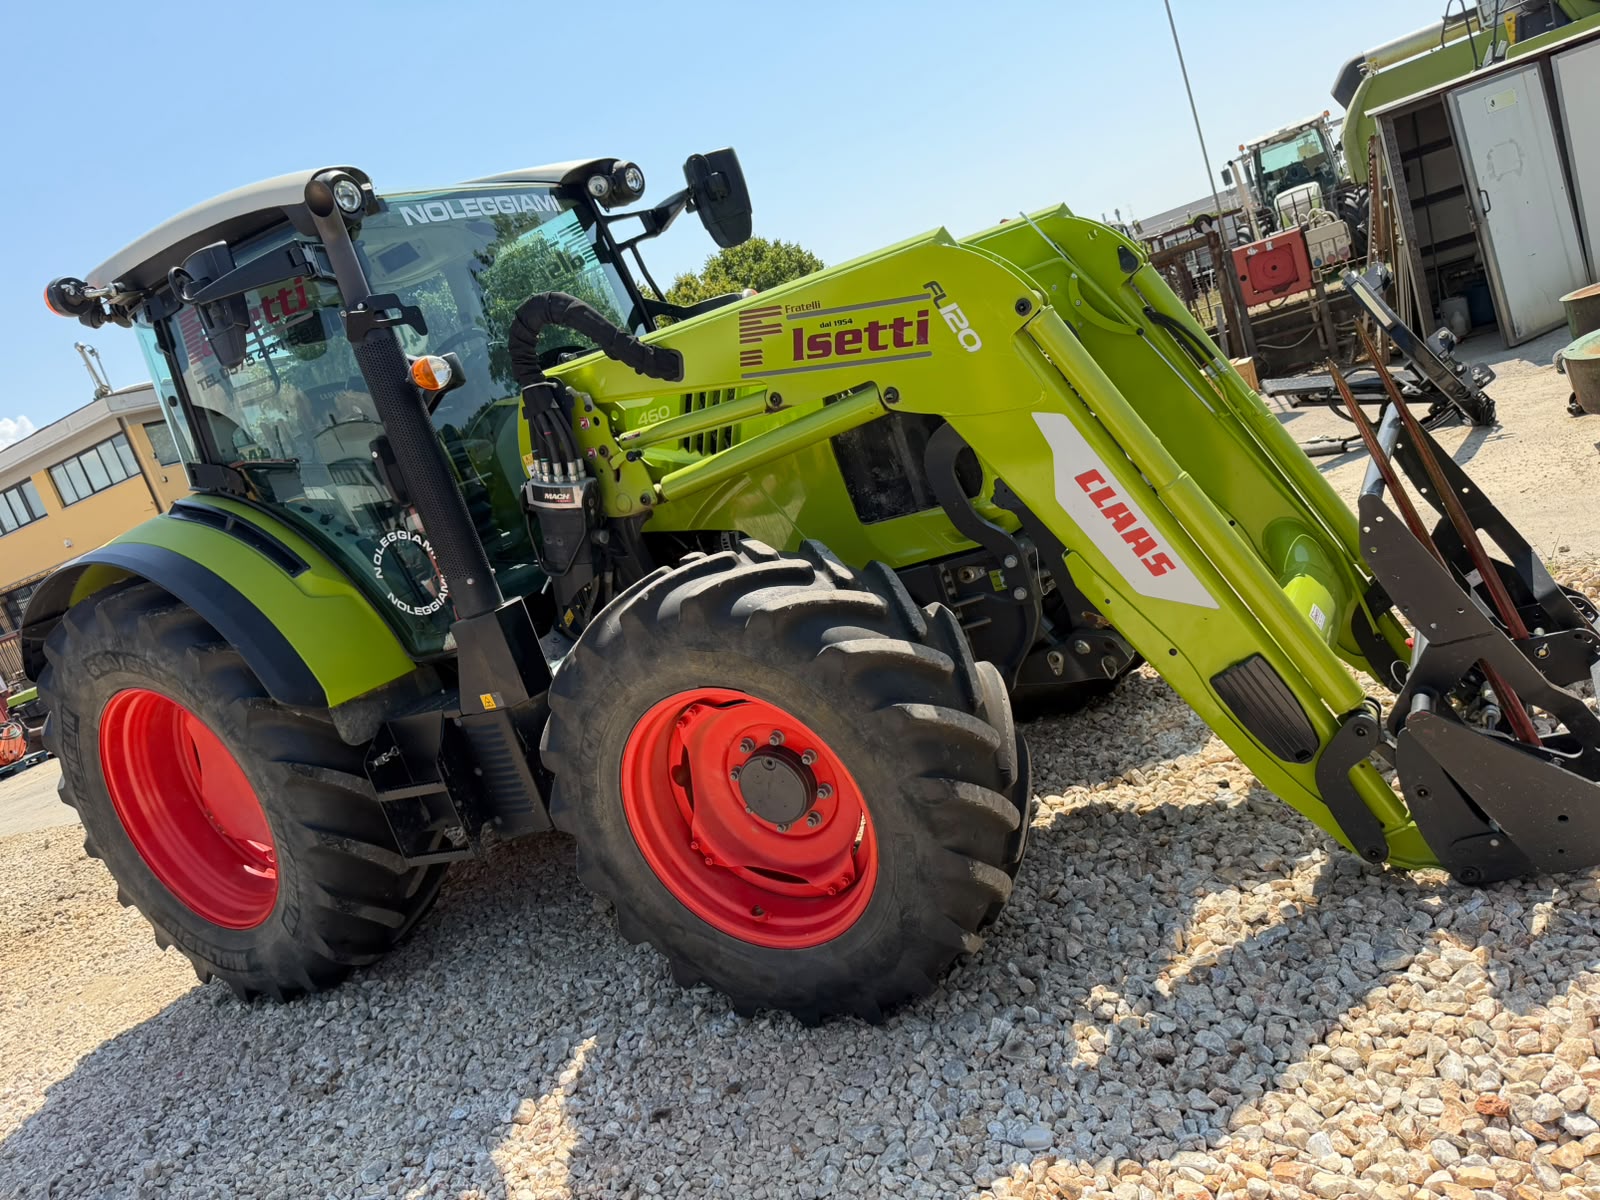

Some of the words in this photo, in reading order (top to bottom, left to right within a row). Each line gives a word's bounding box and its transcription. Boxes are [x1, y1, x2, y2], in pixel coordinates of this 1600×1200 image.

[399, 195, 562, 226] NOLEGGIAMI
[785, 300, 821, 314] Fratelli
[923, 280, 982, 353] FL120
[792, 309, 929, 361] Isetti
[819, 320, 832, 329] dal
[833, 317, 854, 327] 1954
[638, 405, 671, 425] 460
[544, 492, 570, 500] MACH
[1074, 468, 1177, 577] CLAAS
[373, 530, 437, 579] NOLEGGIAM
